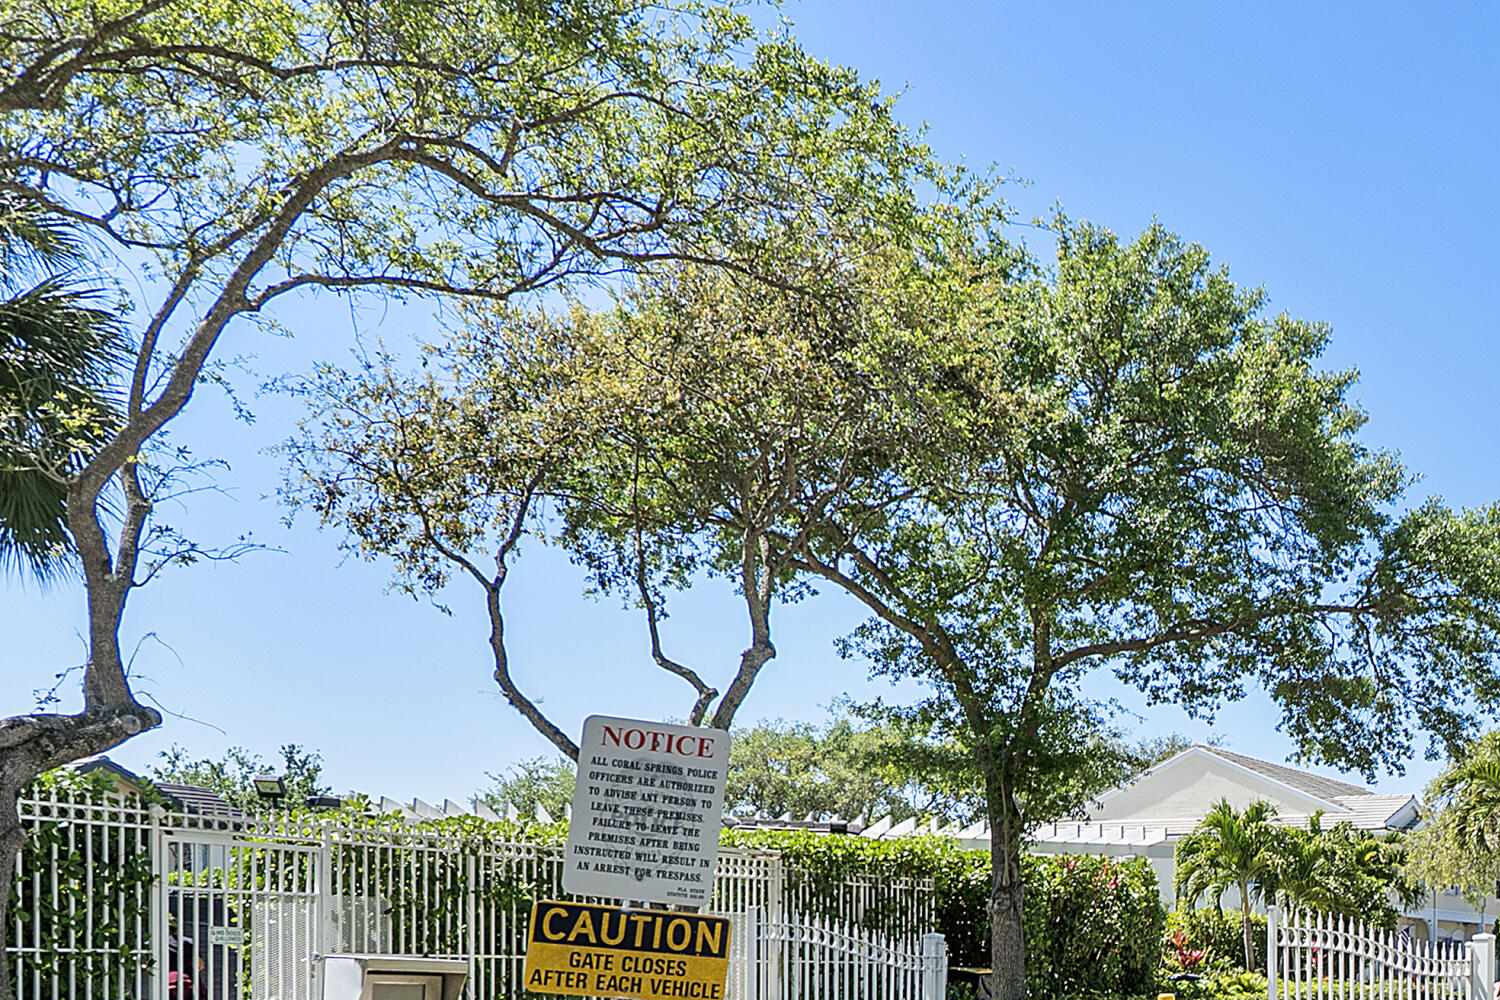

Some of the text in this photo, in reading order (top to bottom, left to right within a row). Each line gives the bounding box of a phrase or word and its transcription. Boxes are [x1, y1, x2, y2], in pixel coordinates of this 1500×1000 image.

[601, 725, 715, 758] NOTICE
[591, 756, 718, 779] ALL CORAL SPRINGS POLICE
[589, 771, 715, 794] OFFICERS ARE AUTHORIZED
[588, 786, 712, 808] TO ADVISE ANY PERSON TO
[590, 802, 620, 813] LEAVE
[624, 806, 653, 817] THESE
[657, 810, 705, 823] PREMISES.
[592, 817, 631, 829] FAILURE
[636, 822, 646, 831] TO
[651, 824, 678, 835] LEAVE
[683, 828, 700, 837] THE
[588, 832, 700, 852] PREMISES AFTER BEING
[574, 845, 710, 868] INSTRUCTED WILL RESULT IN
[576, 861, 703, 883] AN ARREST FOR TRESPASS.
[542, 907, 722, 954] CAUTION
[569, 952, 687, 977] GATE CLOSES
[529, 969, 720, 1000] AFTER EACH VEHICLE
